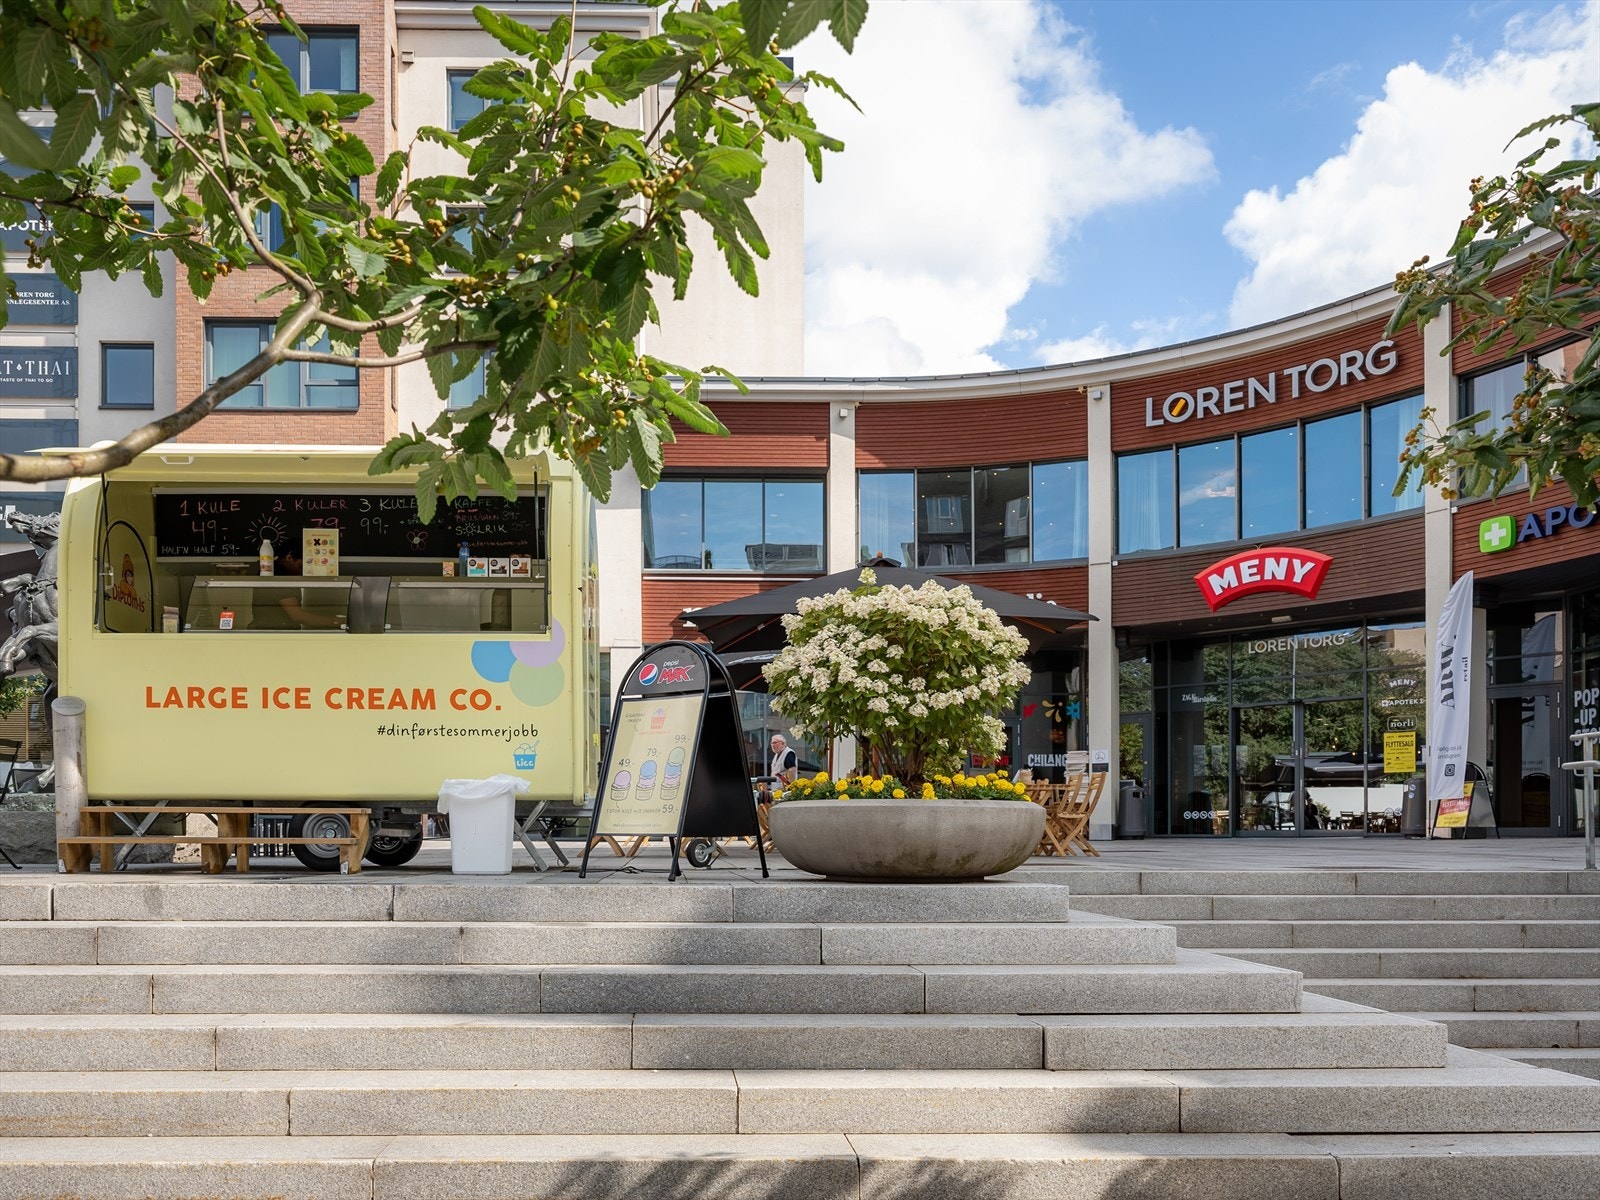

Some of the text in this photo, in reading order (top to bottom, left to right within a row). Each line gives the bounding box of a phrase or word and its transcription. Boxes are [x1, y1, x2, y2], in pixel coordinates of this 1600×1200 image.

[0, 360, 69, 377] T THAI
[1283, 340, 1398, 399] TORG
[180, 500, 241, 516] 1 KULE
[273, 499, 349, 513] 2 KULER
[359, 498, 417, 512] 3 KULE
[1516, 499, 1600, 543] APO
[193, 545, 215, 553] HALF
[1208, 557, 1316, 596] MENY
[1303, 634, 1345, 649] TORG
[662, 659, 679, 667] pepsi
[657, 664, 695, 684] MAX
[1389, 678, 1417, 689] MENY
[145, 686, 502, 711] LARGE ICE CREAM CO.
[1389, 698, 1418, 706] APOTEK
[1574, 687, 1600, 708] POP
[1390, 718, 1414, 728] norli
[1574, 707, 1597, 726] -UP
[376, 723, 539, 742] #dinførstesommerjobb
[1385, 740, 1414, 748] FLYTTESALG
